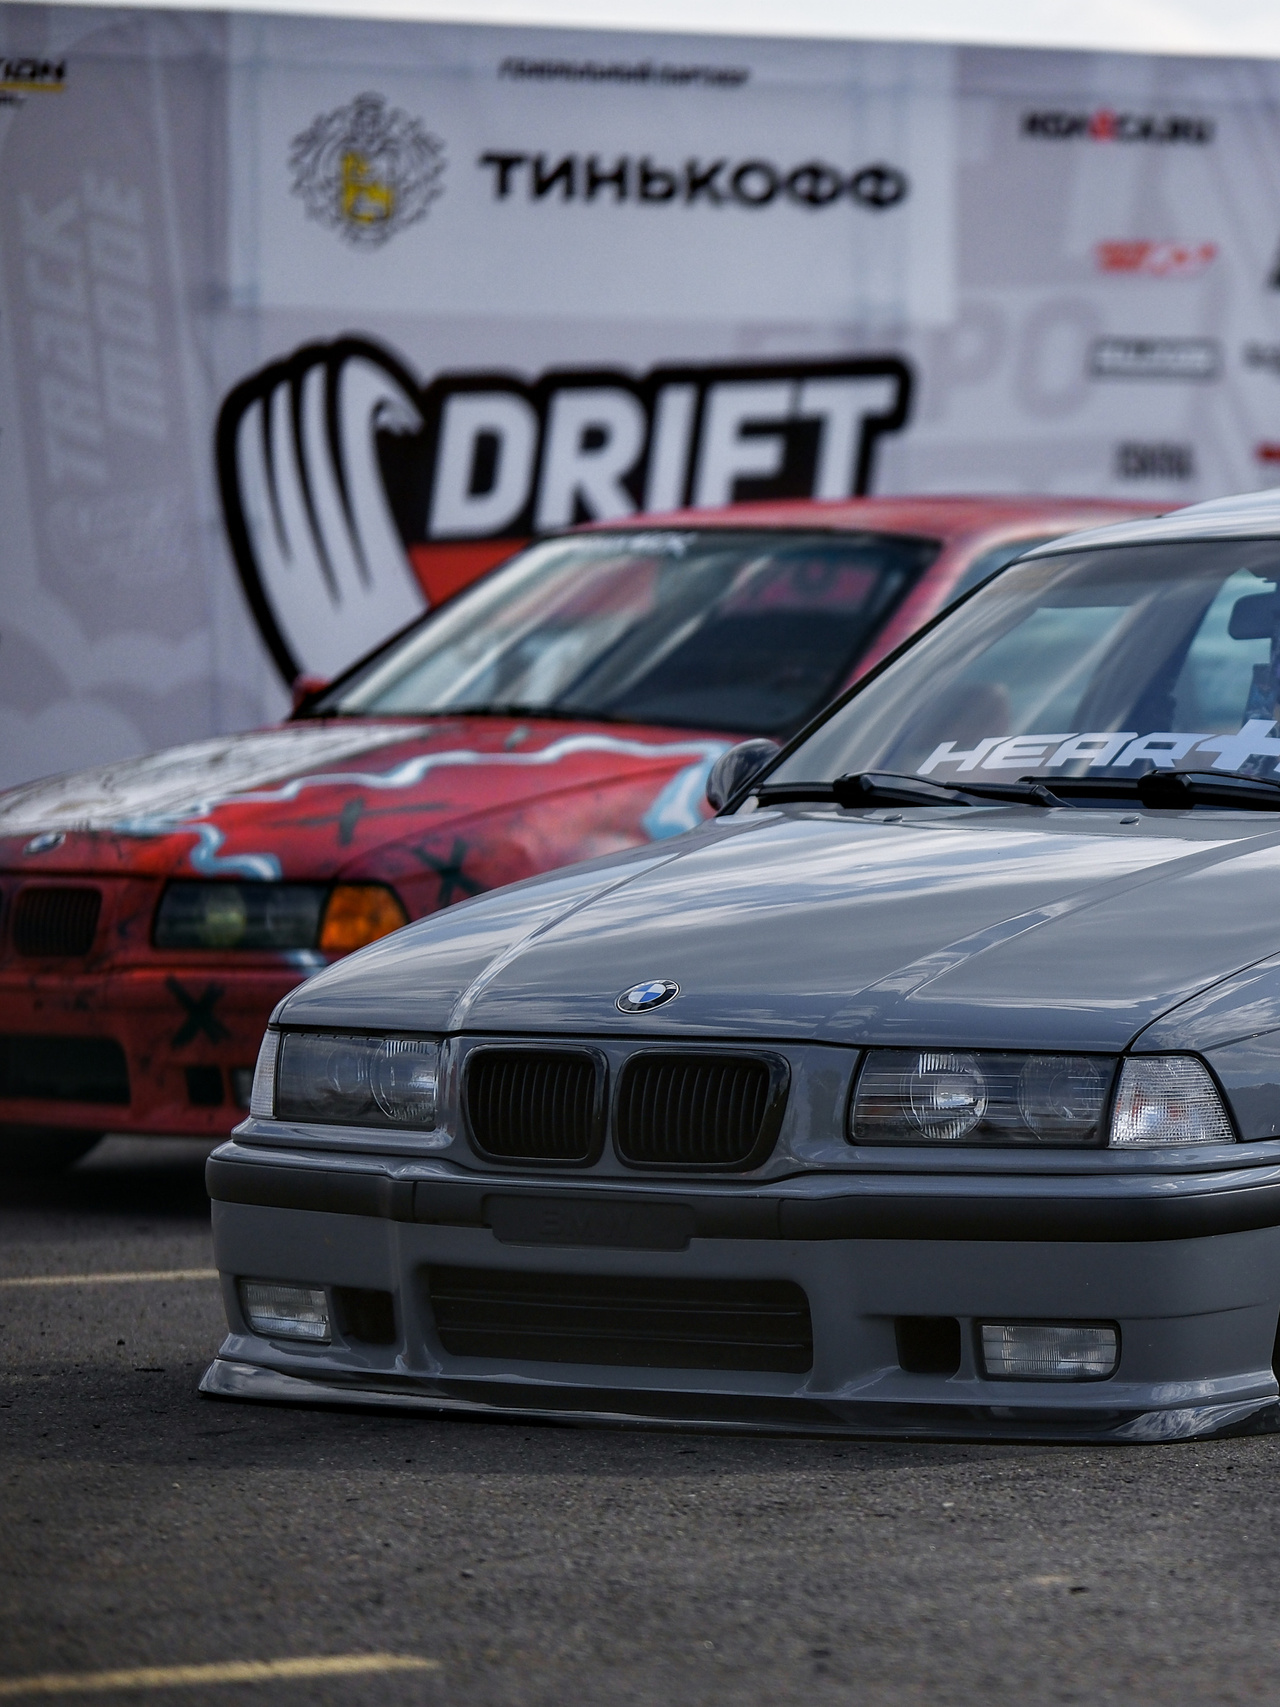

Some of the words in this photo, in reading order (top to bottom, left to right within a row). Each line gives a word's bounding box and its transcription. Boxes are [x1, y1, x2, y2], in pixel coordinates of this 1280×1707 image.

[479, 149, 907, 215] ТИНЬКОФФ
[426, 374, 899, 540] DRIFT
[540, 1208, 635, 1239] BMW
